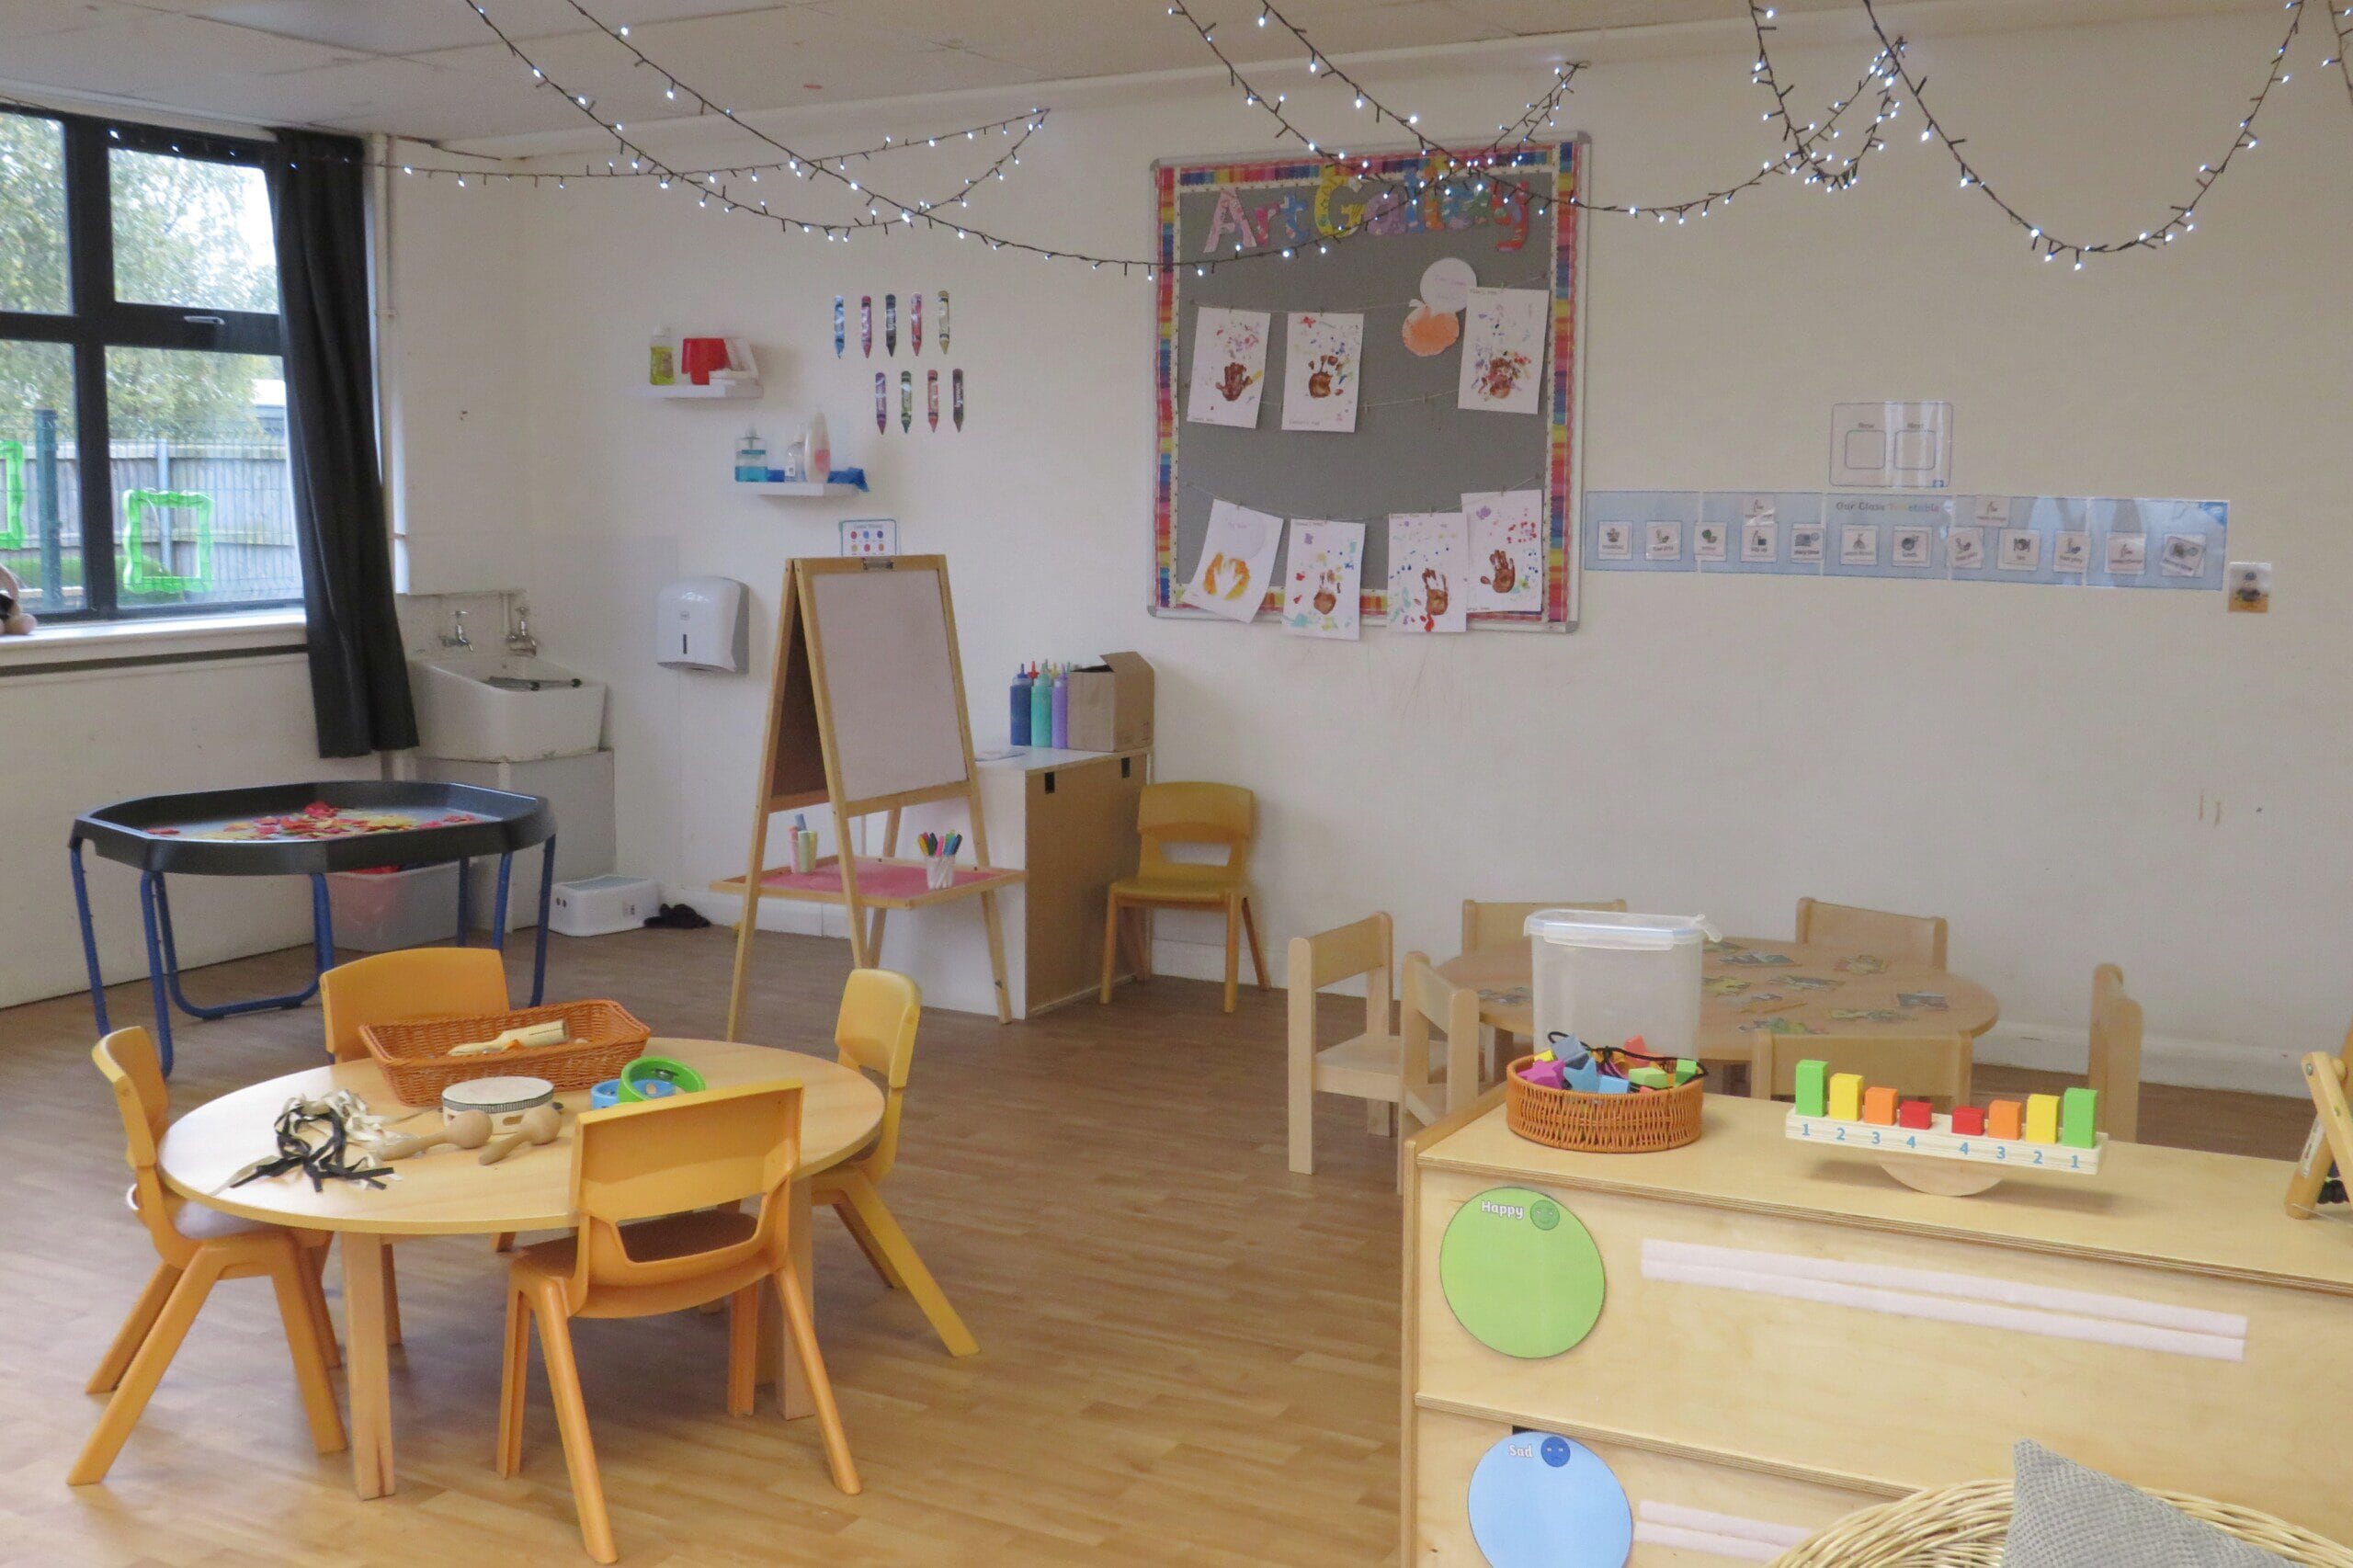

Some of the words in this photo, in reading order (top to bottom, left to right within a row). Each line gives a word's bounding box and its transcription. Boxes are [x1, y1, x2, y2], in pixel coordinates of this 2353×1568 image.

[1203, 187, 1309, 254] Art
[1836, 501, 1855, 512] Our
[1859, 501, 1885, 511] Class
[1802, 1124, 1811, 1136] 1
[1836, 1128, 1846, 1141] 2
[1871, 1131, 1881, 1144] 3
[1906, 1136, 1916, 1149] 4
[1960, 1142, 1970, 1155] 4
[1996, 1146, 2006, 1159] 3
[2033, 1151, 2043, 1165] 2
[2071, 1155, 2080, 1168] 1
[1481, 1200, 1524, 1220] Happy
[1508, 1444, 1533, 1458] Sad
